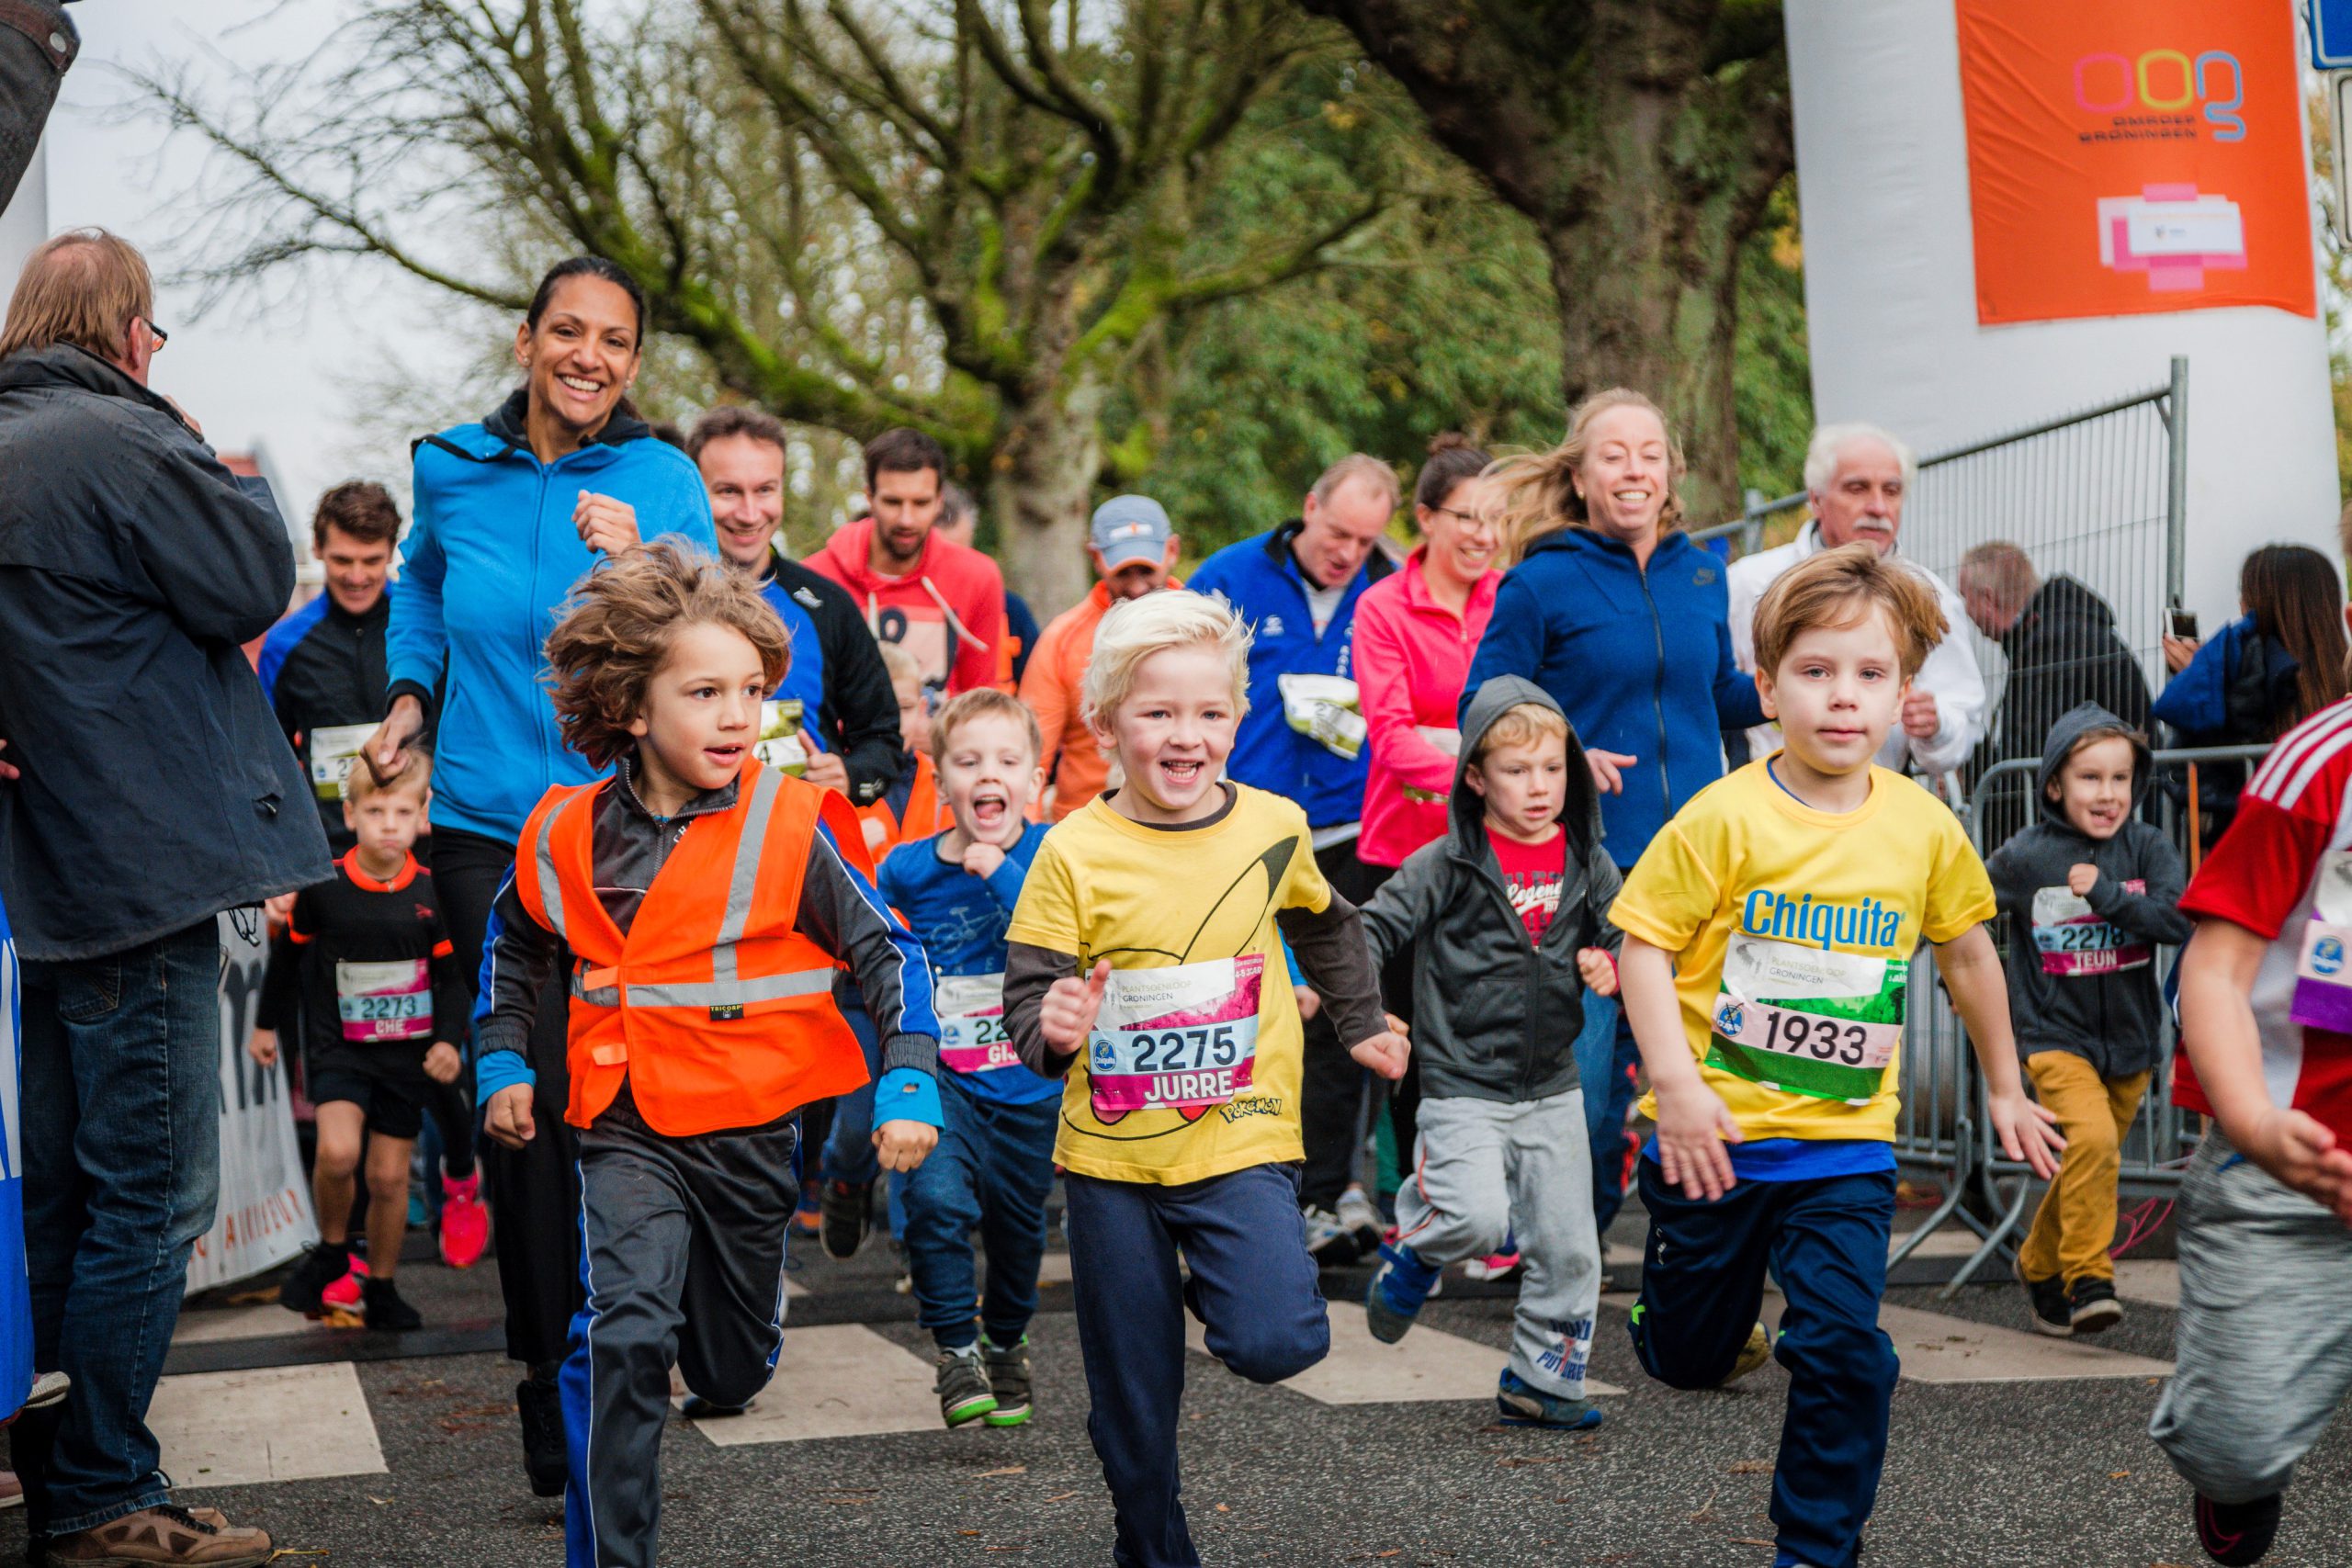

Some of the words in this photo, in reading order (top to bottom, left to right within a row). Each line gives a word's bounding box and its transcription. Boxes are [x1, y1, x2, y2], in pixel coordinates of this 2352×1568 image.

[2078, 129, 2199, 142] GRONINGEN
[1743, 889, 1900, 951] Chiquita
[2062, 925, 2125, 950] 2278
[2074, 950, 2117, 970] TEUN
[1770, 967, 1824, 984] GRONINGEN
[361, 995, 416, 1019] 2273
[1123, 992, 1173, 1002] GRONINGEN
[375, 1019, 405, 1034] CHE
[1766, 1011, 1868, 1066] 1933
[1131, 1026, 1237, 1072] 2275
[1144, 1070, 1234, 1101] JURRE
